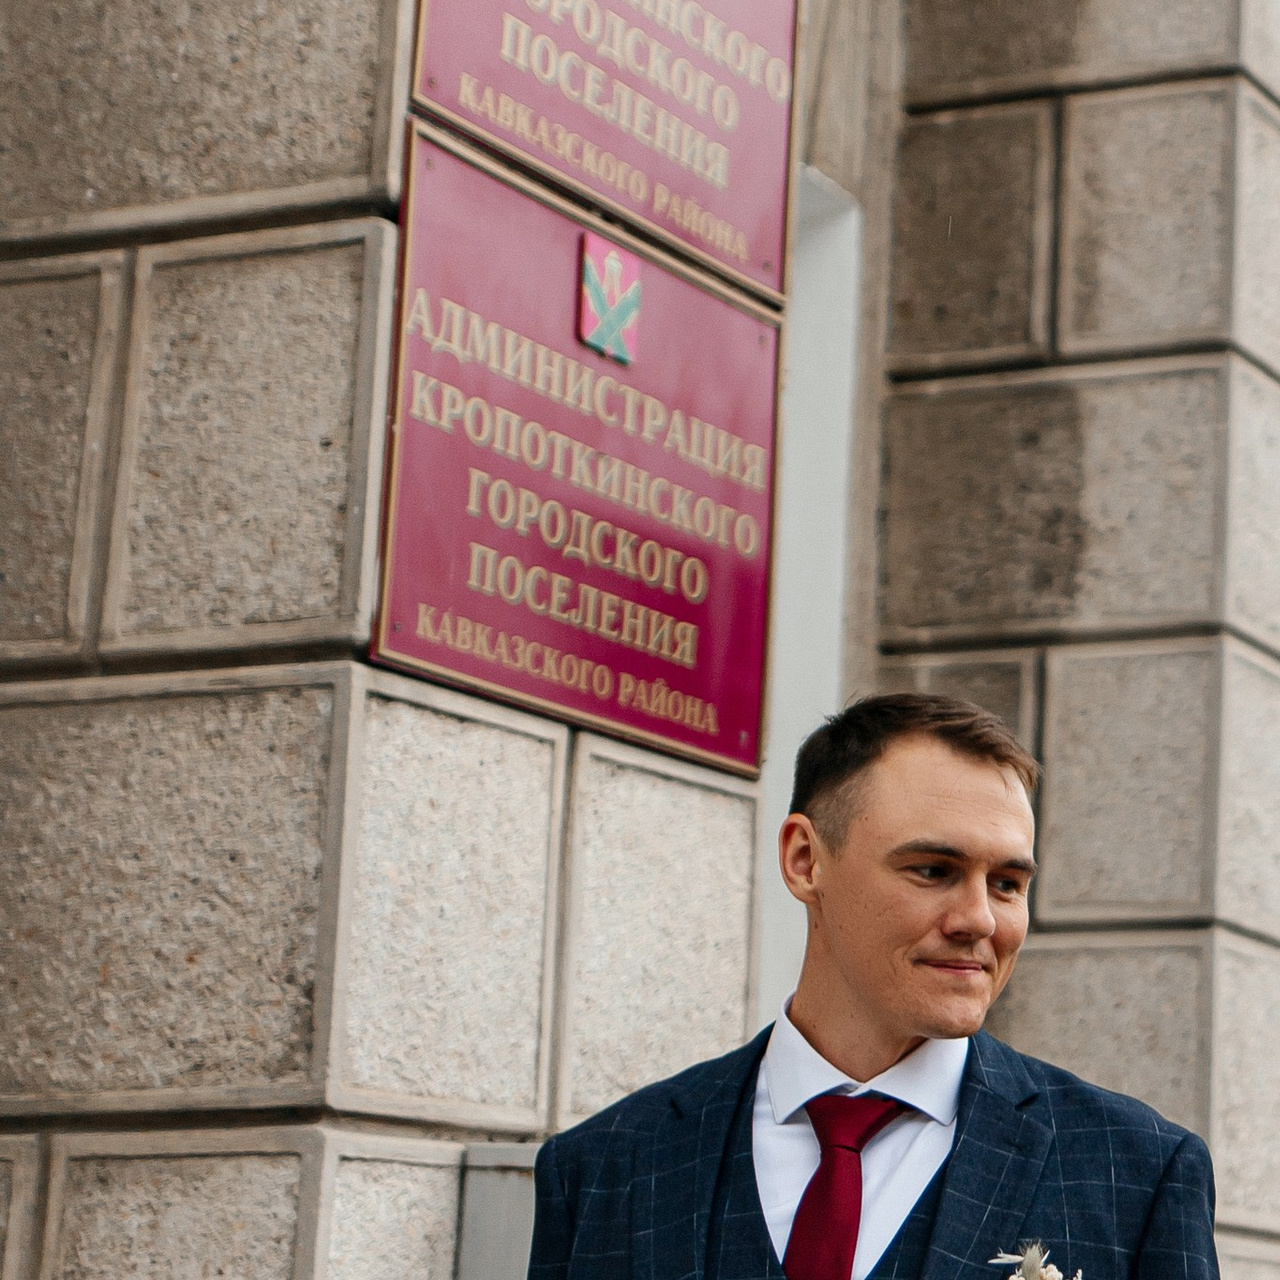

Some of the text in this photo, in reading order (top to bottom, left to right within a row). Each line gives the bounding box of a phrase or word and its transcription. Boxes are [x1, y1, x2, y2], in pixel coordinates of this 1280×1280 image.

[458, 72, 750, 264] КАВКАЗСКОГО РАЙОНА
[501, 14, 731, 191] ПОСЕЛЕНИЯ
[406, 287, 767, 492] АДМИНИСТРАЦИЯ
[410, 370, 760, 558] КРОПОТКИНСКОГО
[466, 468, 708, 603] ГОРОДСКОГО
[468, 542, 698, 669] ПОСЕЛЕНИЯ
[416, 602, 719, 736] КАВКАЗСКОГО РАЙОНА
